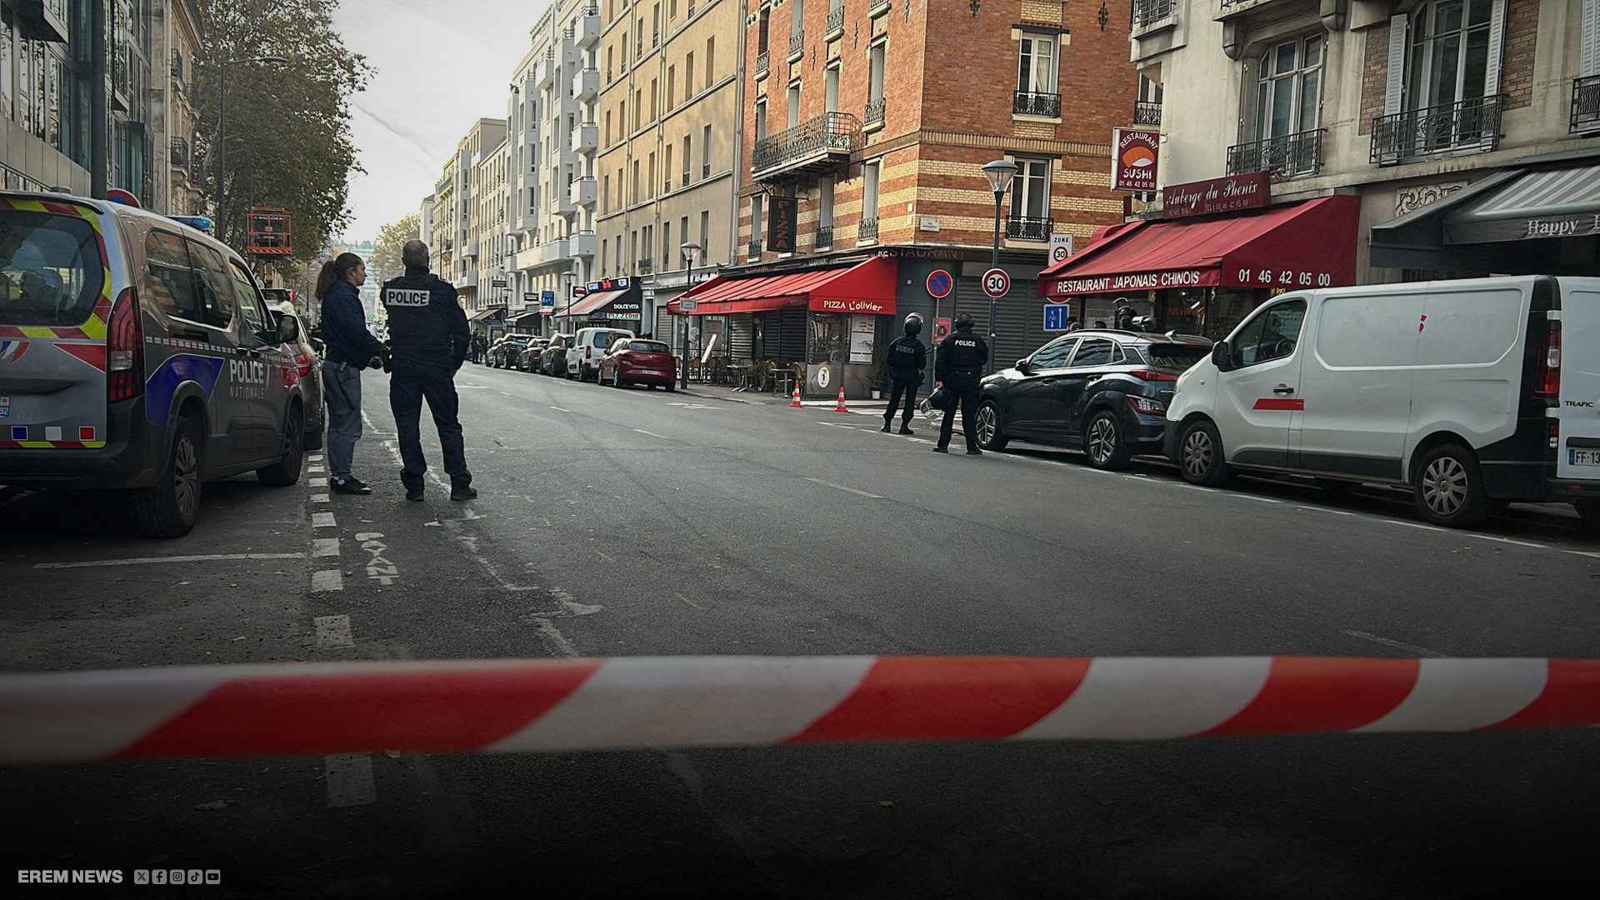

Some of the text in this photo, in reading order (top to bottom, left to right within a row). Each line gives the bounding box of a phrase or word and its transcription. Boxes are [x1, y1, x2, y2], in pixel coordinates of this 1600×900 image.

[1120, 132, 1158, 149] RESTAURANT
[1123, 168, 1152, 179] SUSHI
[1166, 189, 1201, 209] Auberge
[1205, 184, 1218, 199] du
[1223, 180, 1258, 197] Phenix
[1528, 219, 1579, 236] Happy
[1057, 250, 1065, 258] 30
[989, 277, 1004, 290] 30
[1057, 270, 1200, 294] RESTAURANT JAPONAIS CHINOIS
[1238, 268, 1330, 287] 01 46 42 05 00
[388, 291, 428, 304] POLICE
[823, 300, 846, 309] PIZZA
[229, 359, 264, 384] POLICE
[1566, 400, 1593, 408] TRAFIC
